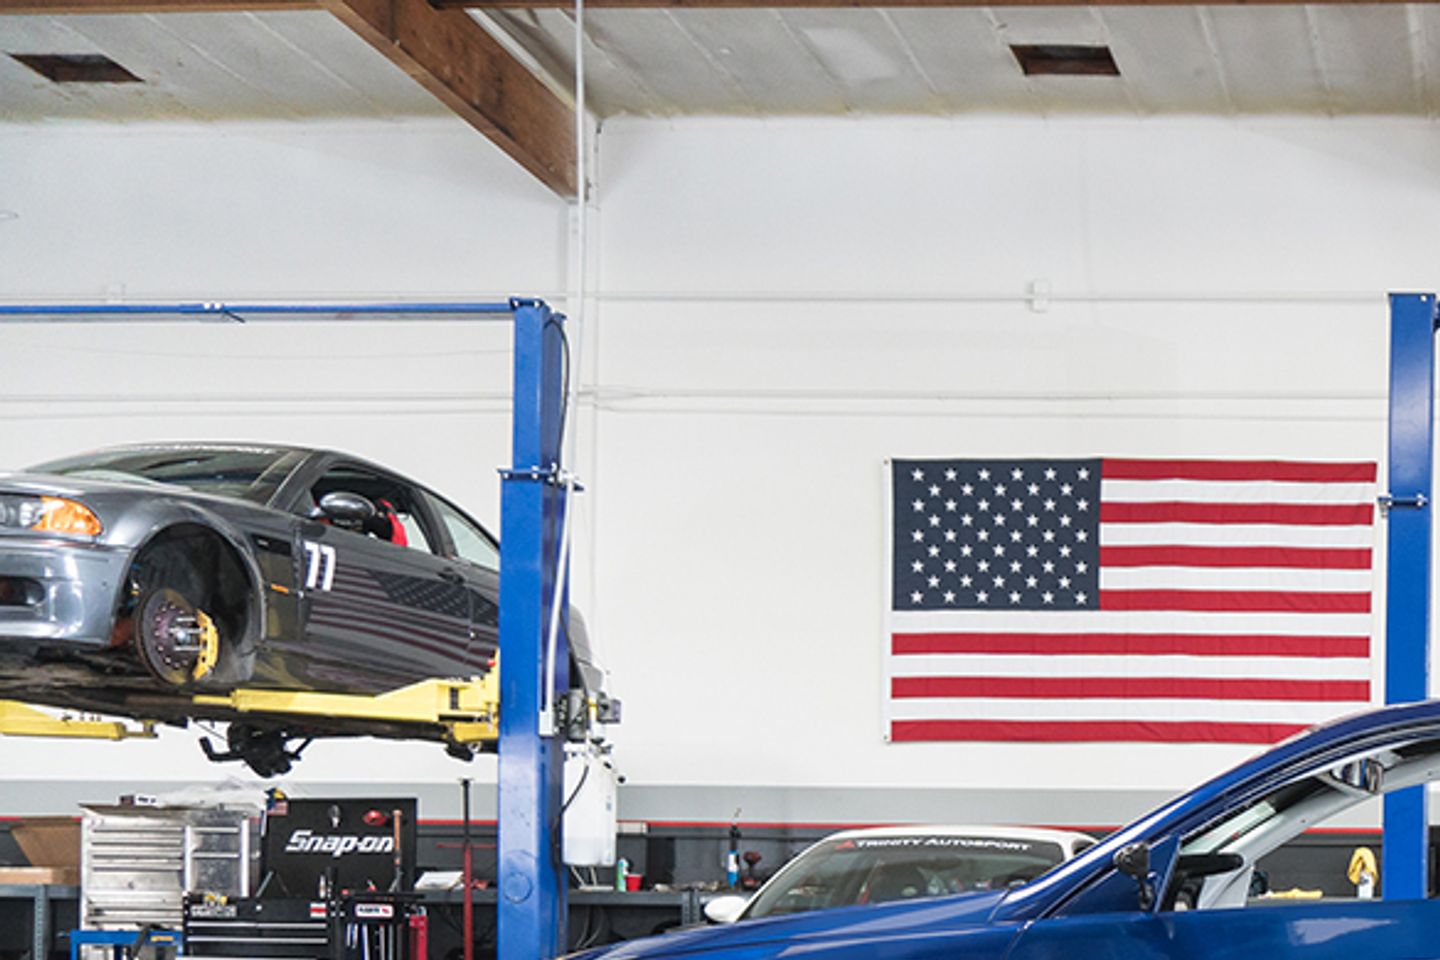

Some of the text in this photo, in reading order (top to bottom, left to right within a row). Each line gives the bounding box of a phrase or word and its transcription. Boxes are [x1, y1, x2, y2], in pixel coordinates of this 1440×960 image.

[285, 829, 395, 857] Snap-on
[857, 838, 1032, 851] TRINITY AUTOSPORT
